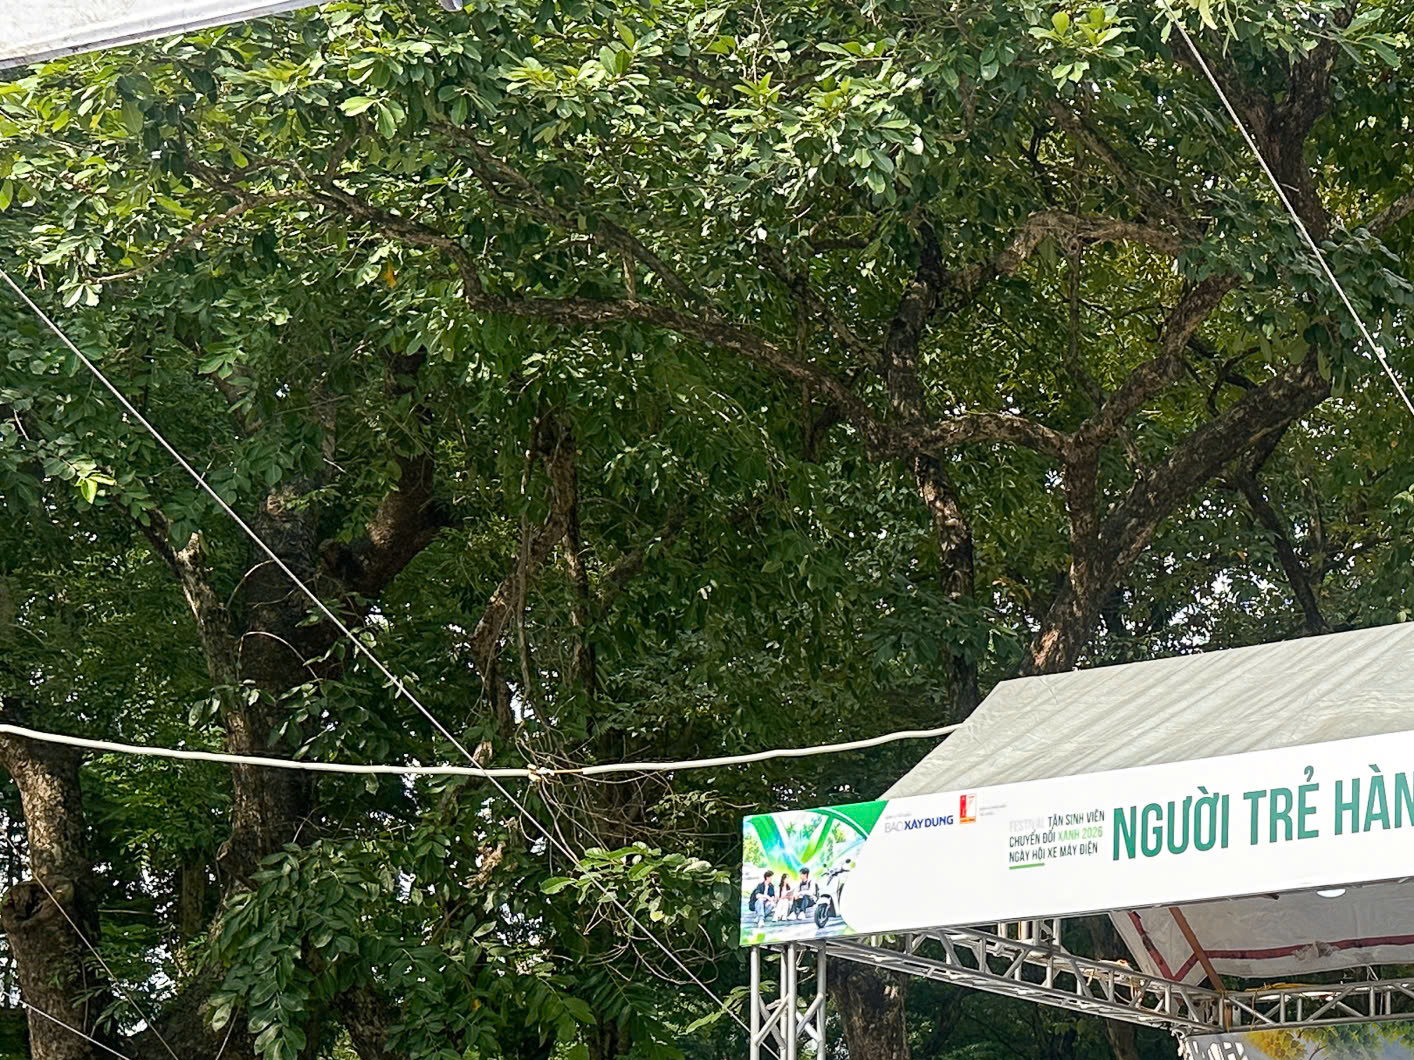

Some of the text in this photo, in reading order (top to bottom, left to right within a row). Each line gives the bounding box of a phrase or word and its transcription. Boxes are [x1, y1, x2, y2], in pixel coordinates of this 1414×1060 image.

[1048, 813, 1063, 827] TÂN
[1066, 812, 1084, 826] SINH
[1086, 809, 1105, 824] VIÊN
[1113, 786, 1229, 861] NGƯỜI
[1243, 766, 1320, 847] TRẺ
[1058, 829, 1080, 841] XANH
[1082, 826, 1104, 840] 2026
[1009, 848, 1030, 863] NGÀY
[1047, 846, 1058, 859] XE
[1079, 840, 1098, 857] ĐIỆN
